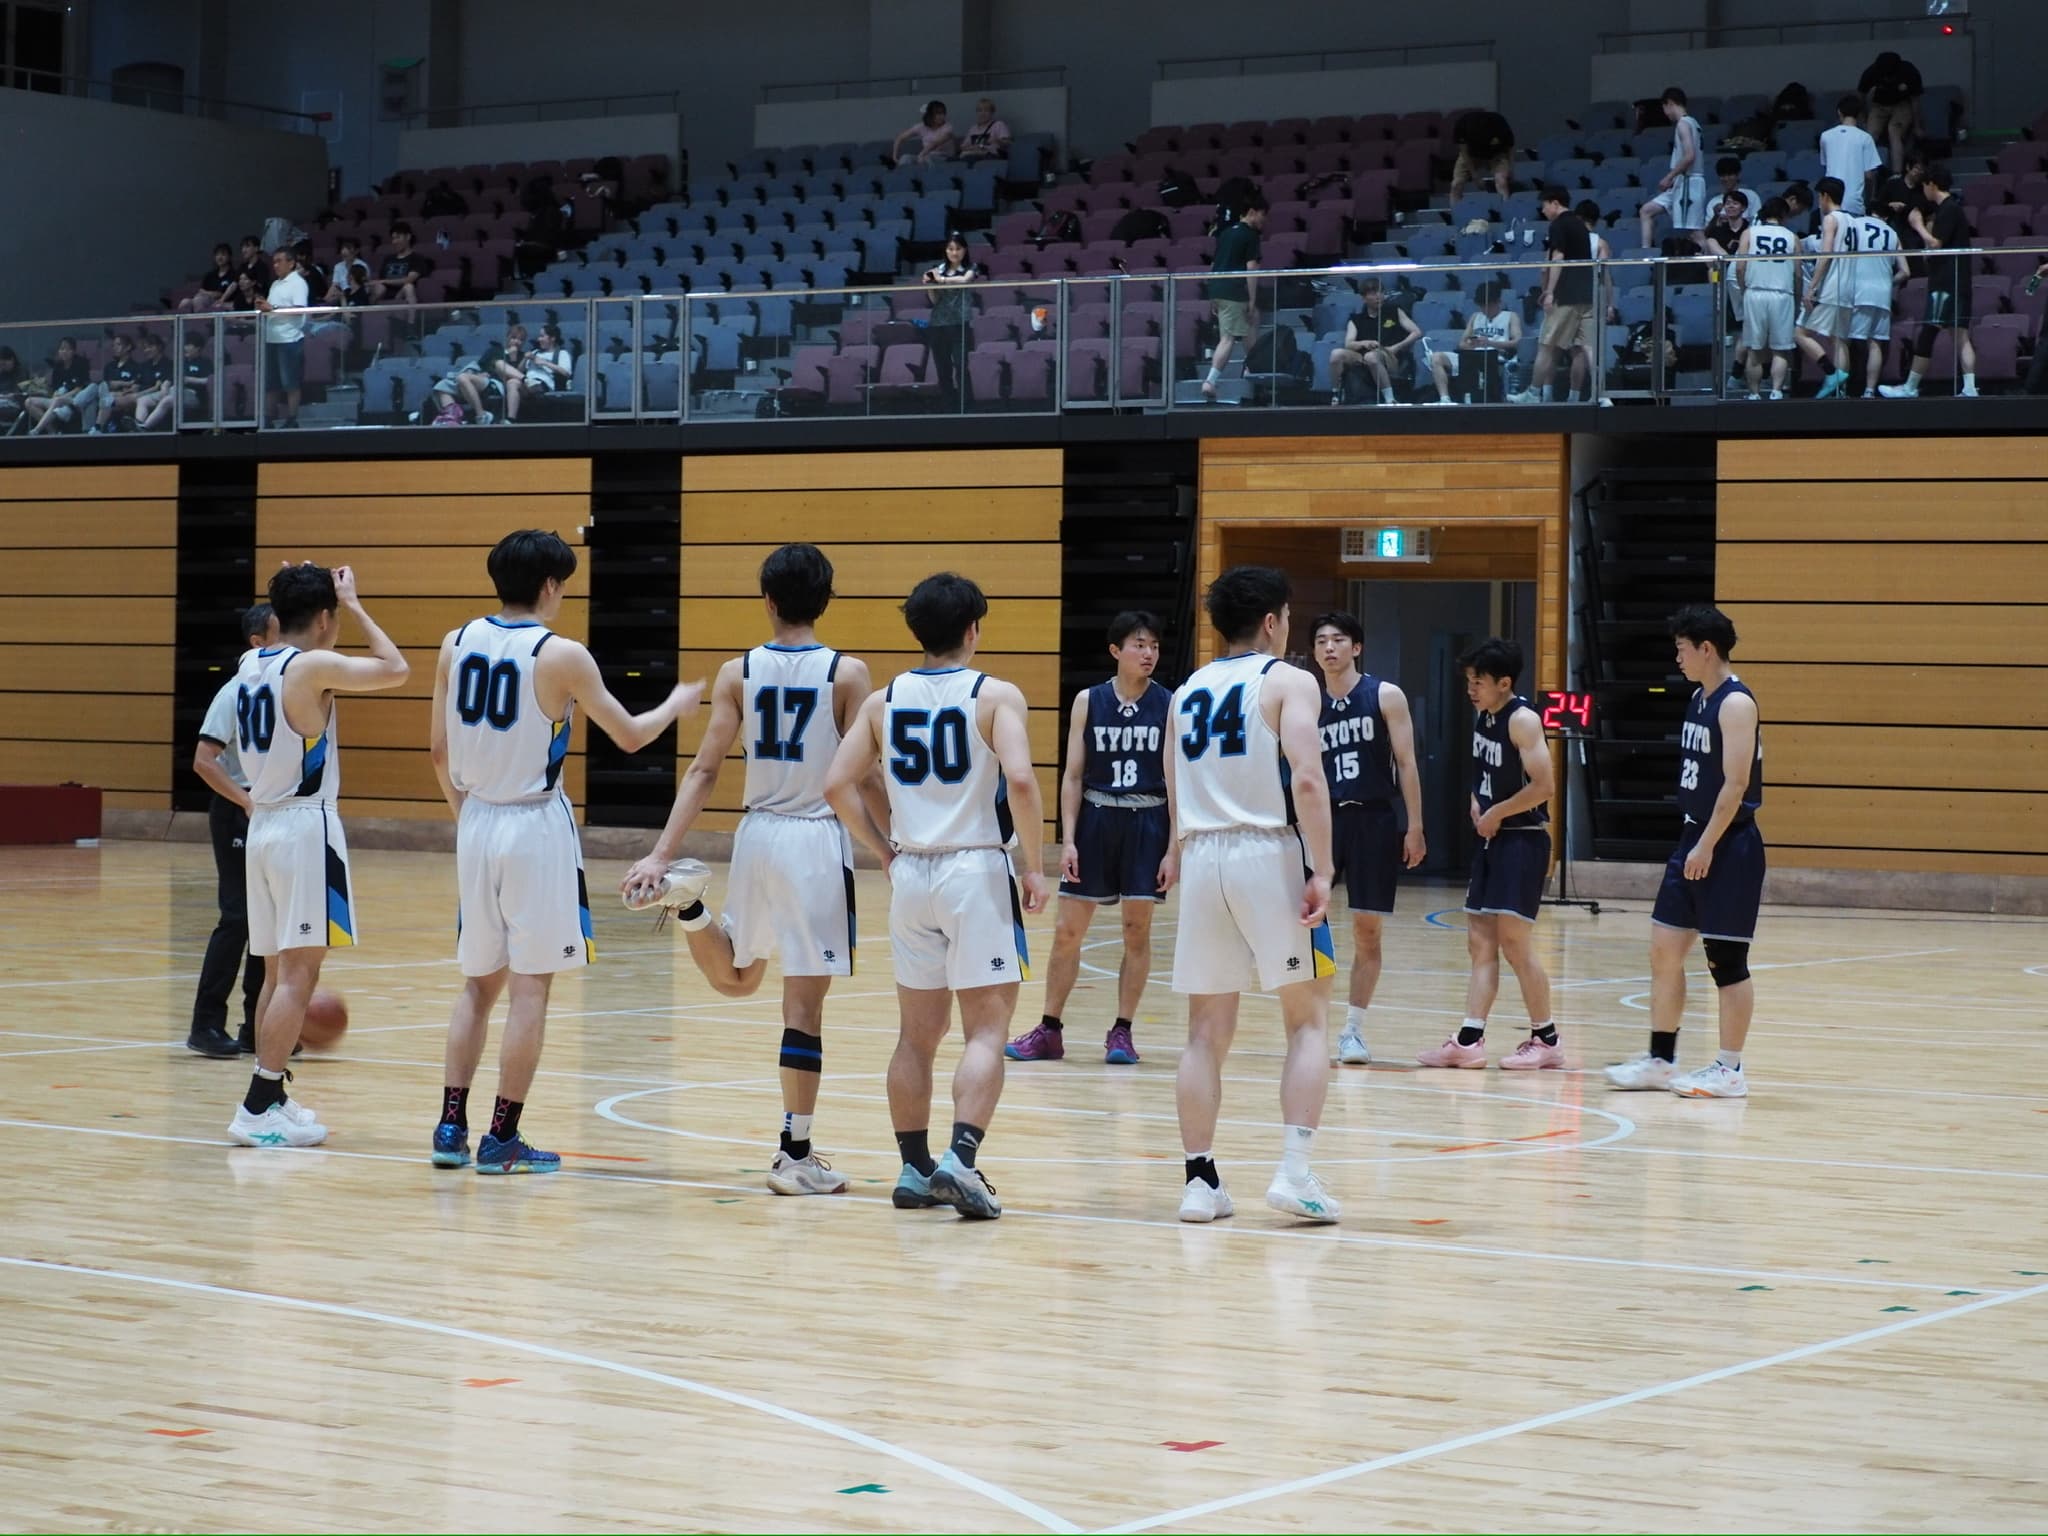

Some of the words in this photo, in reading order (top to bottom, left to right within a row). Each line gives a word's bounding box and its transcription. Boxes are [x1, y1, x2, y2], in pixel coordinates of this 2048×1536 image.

[1756, 236, 1788, 263] 58
[1865, 222, 1890, 251] 71
[457, 651, 521, 732] 00
[754, 686, 818, 762] 17
[1180, 682, 1247, 762] 34
[1543, 692, 1592, 728] 24
[890, 706, 972, 786] 50
[1093, 725, 1161, 752] KYOTO
[1319, 716, 1374, 753] KYOTO
[1111, 759, 1138, 787] 18
[1334, 751, 1360, 783] 15
[1680, 758, 1699, 791] 23
